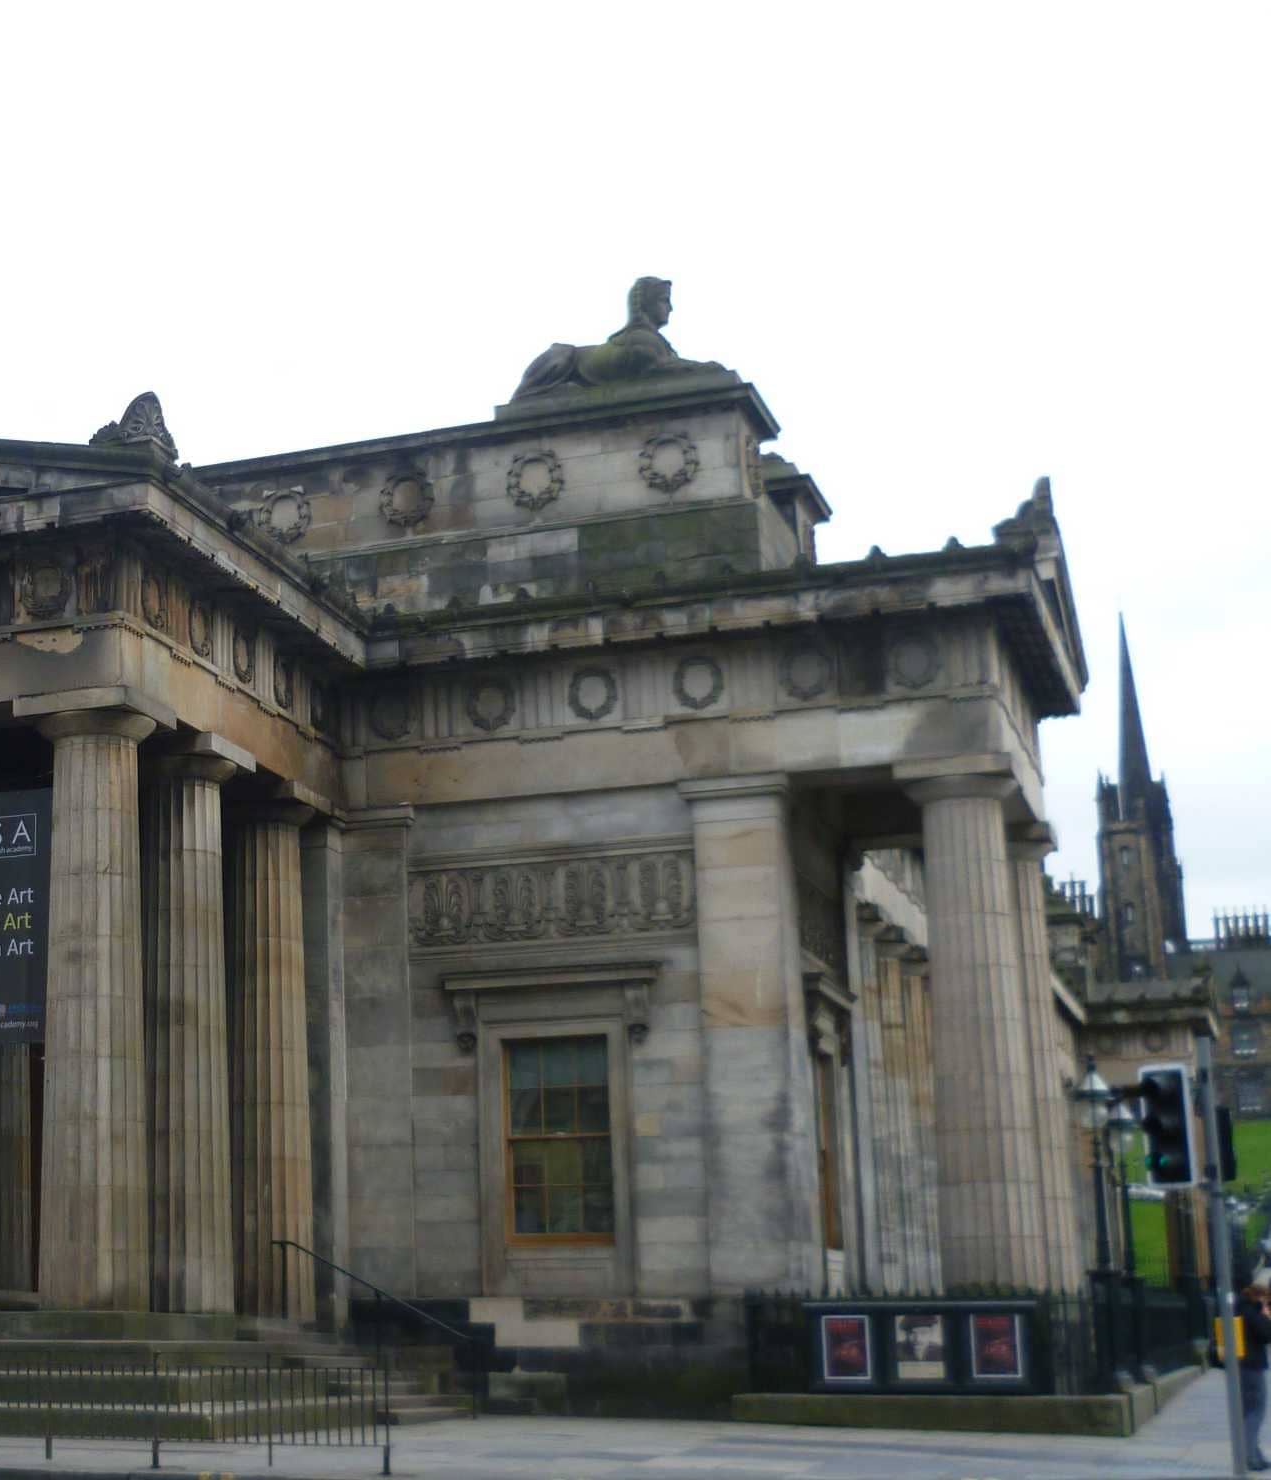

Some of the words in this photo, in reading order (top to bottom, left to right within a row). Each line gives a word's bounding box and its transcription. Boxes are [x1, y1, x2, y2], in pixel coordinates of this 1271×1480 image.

[7, 887, 34, 905] Art
[3, 912, 32, 930] Art
[7, 938, 34, 956] Art
